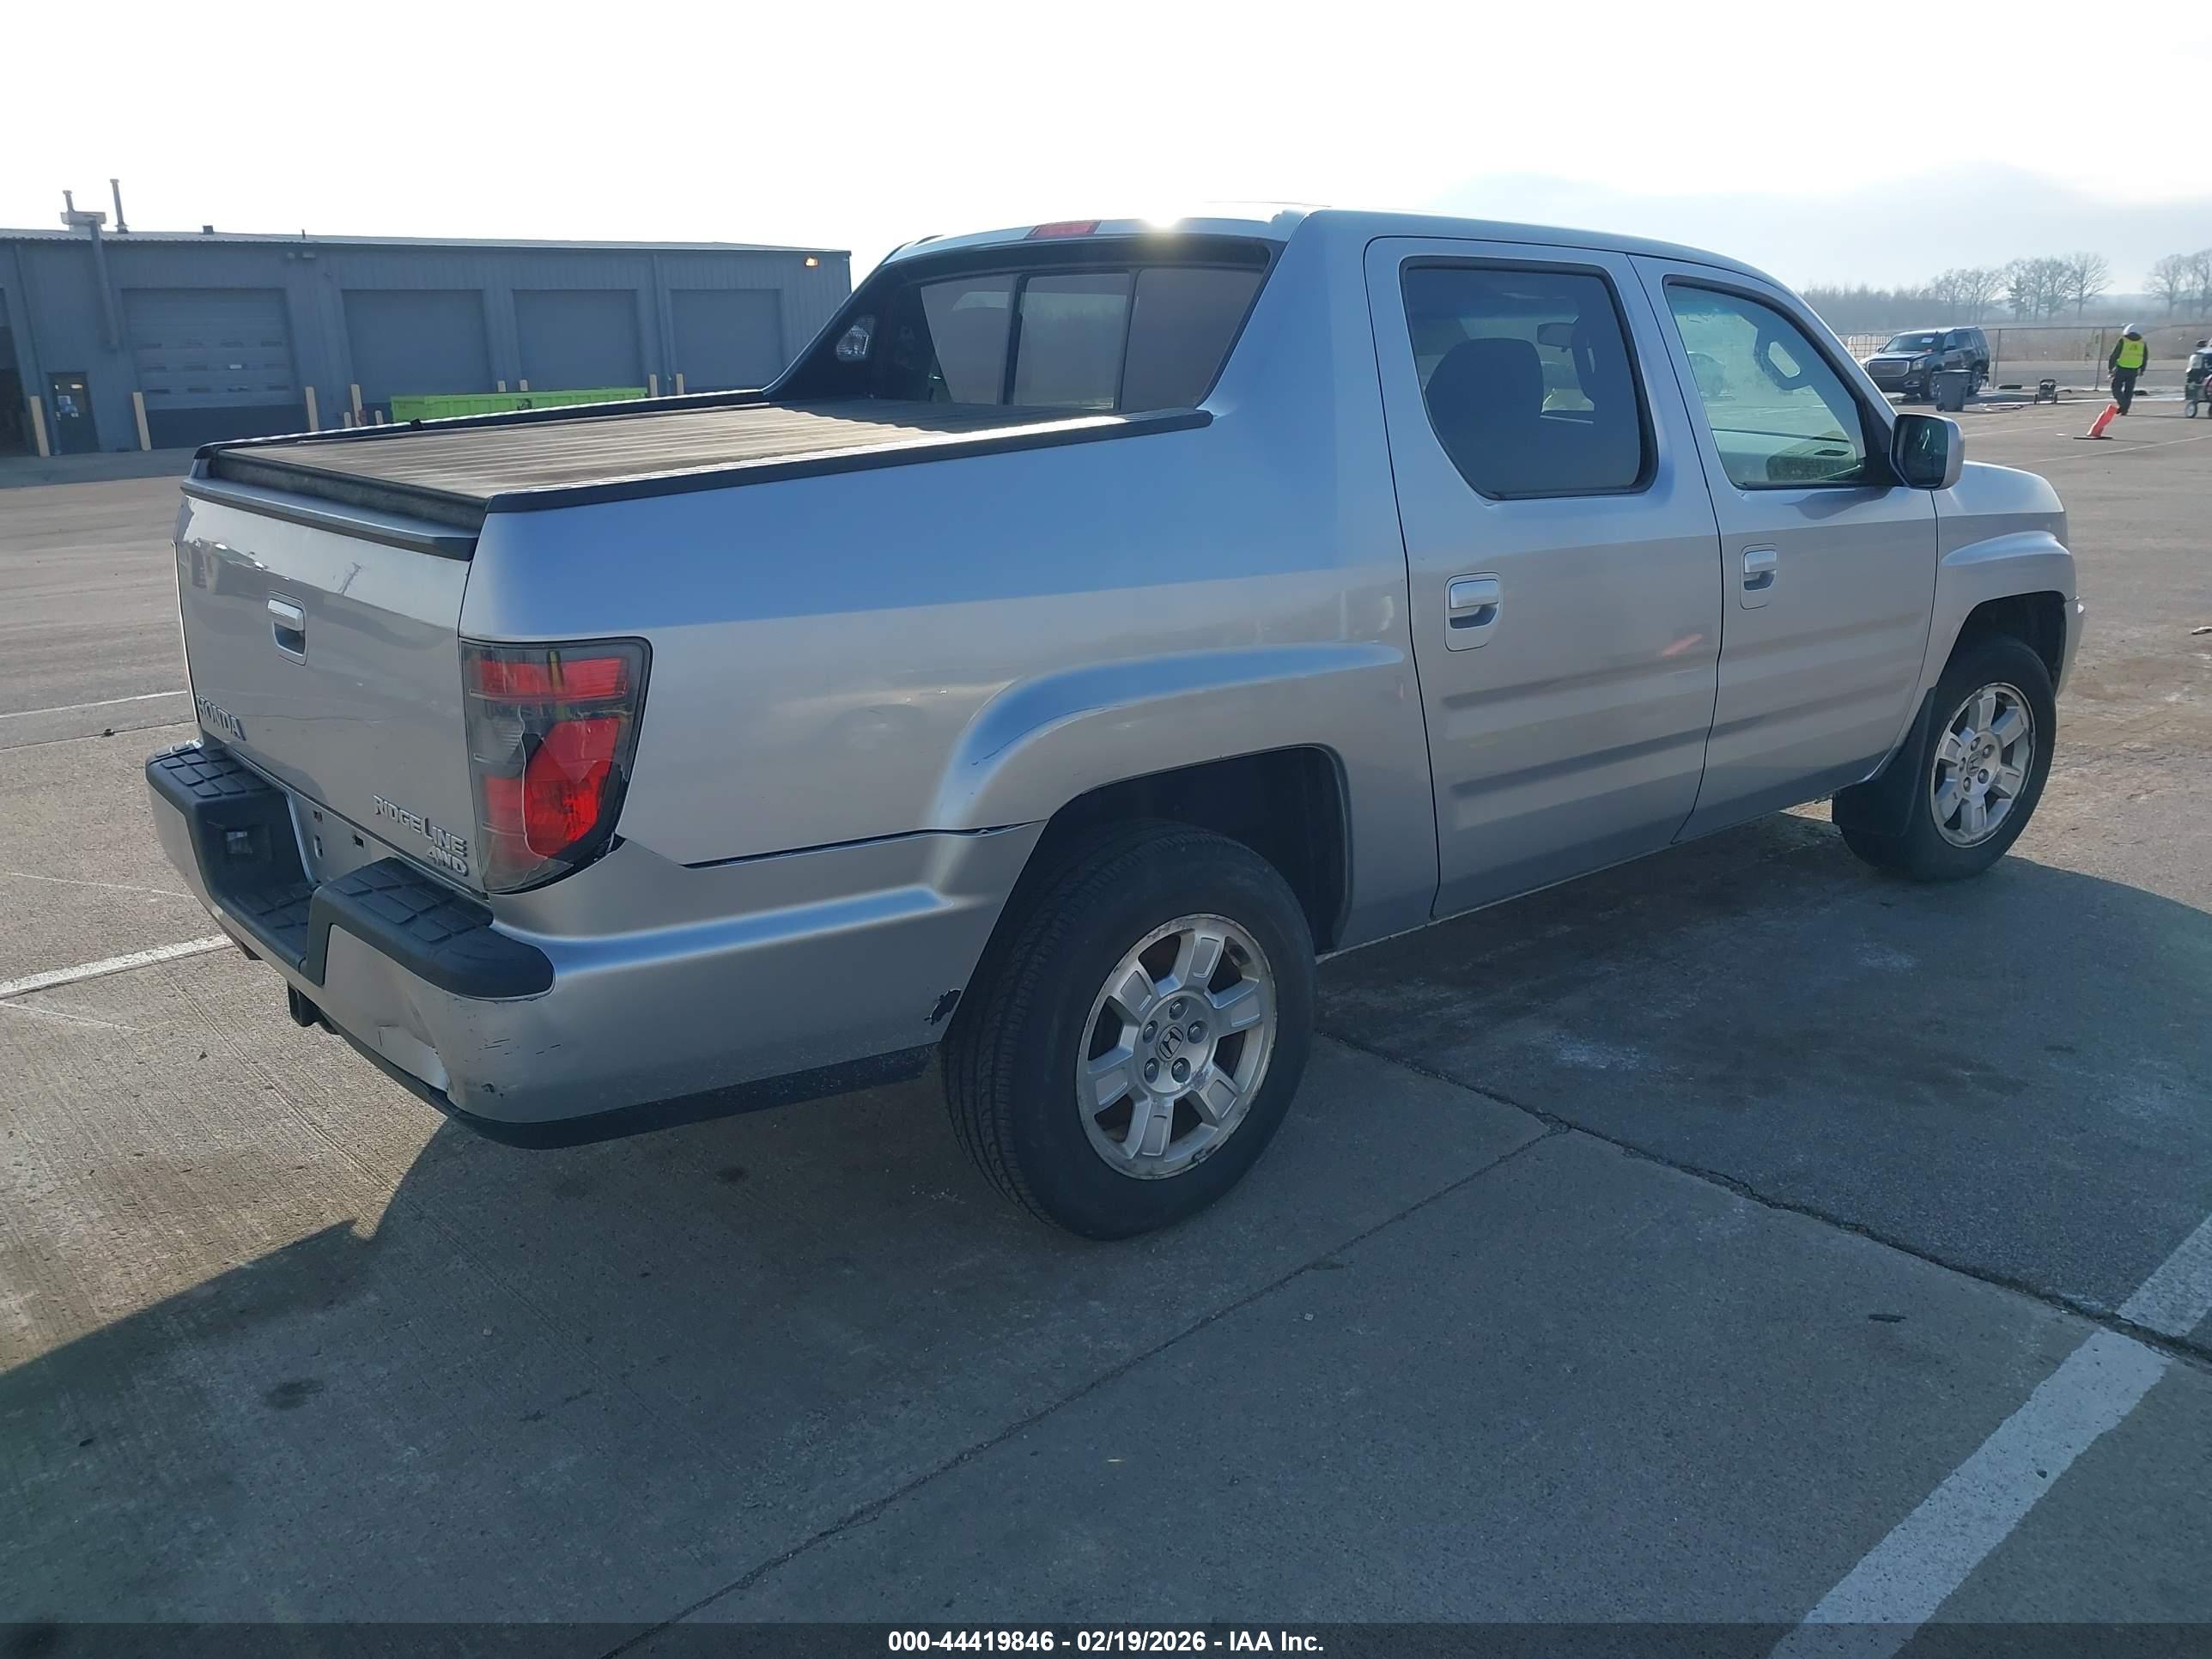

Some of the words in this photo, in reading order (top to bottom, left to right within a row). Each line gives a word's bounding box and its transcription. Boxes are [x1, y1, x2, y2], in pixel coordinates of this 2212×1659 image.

[195, 694, 246, 741] HONDA
[373, 793, 467, 857] RIDGELINE
[427, 845, 469, 876] 4WD
